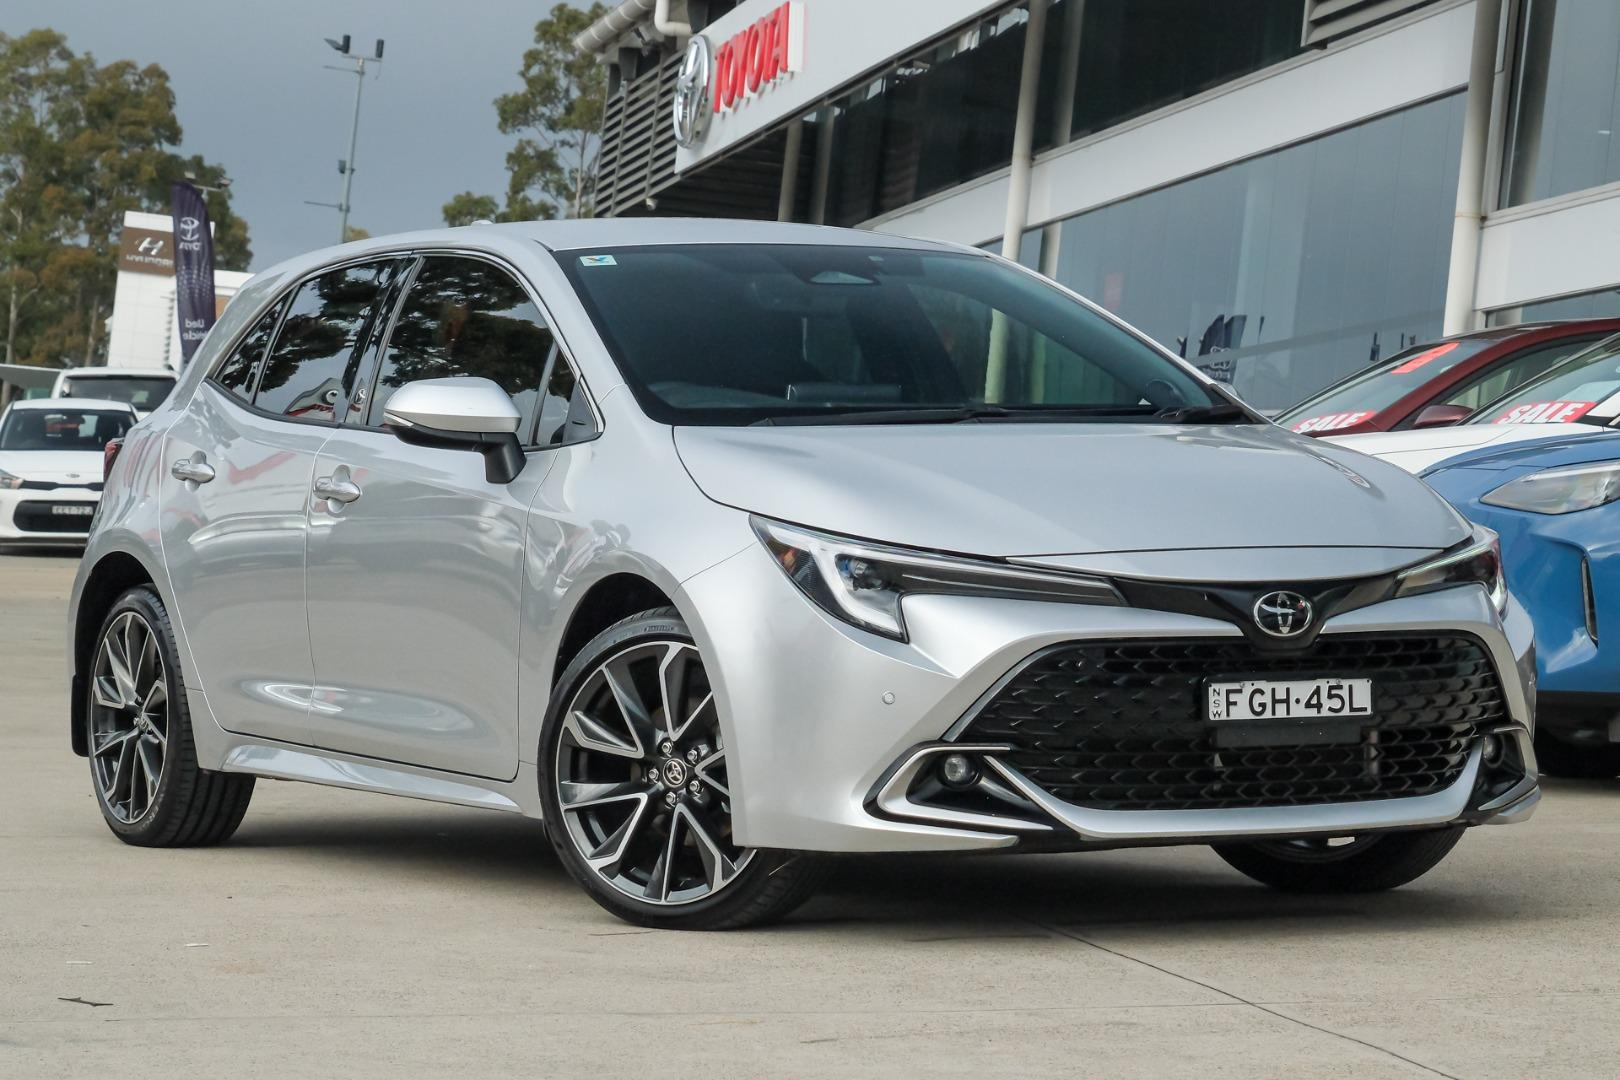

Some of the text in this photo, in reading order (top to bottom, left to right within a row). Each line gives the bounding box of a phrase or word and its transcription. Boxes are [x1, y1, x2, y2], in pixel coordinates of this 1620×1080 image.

[713, 1, 790, 114] TOYOTA
[1293, 412, 1368, 434] SALE
[1499, 401, 1585, 424] SALE
[1212, 687, 1223, 719] NSW
